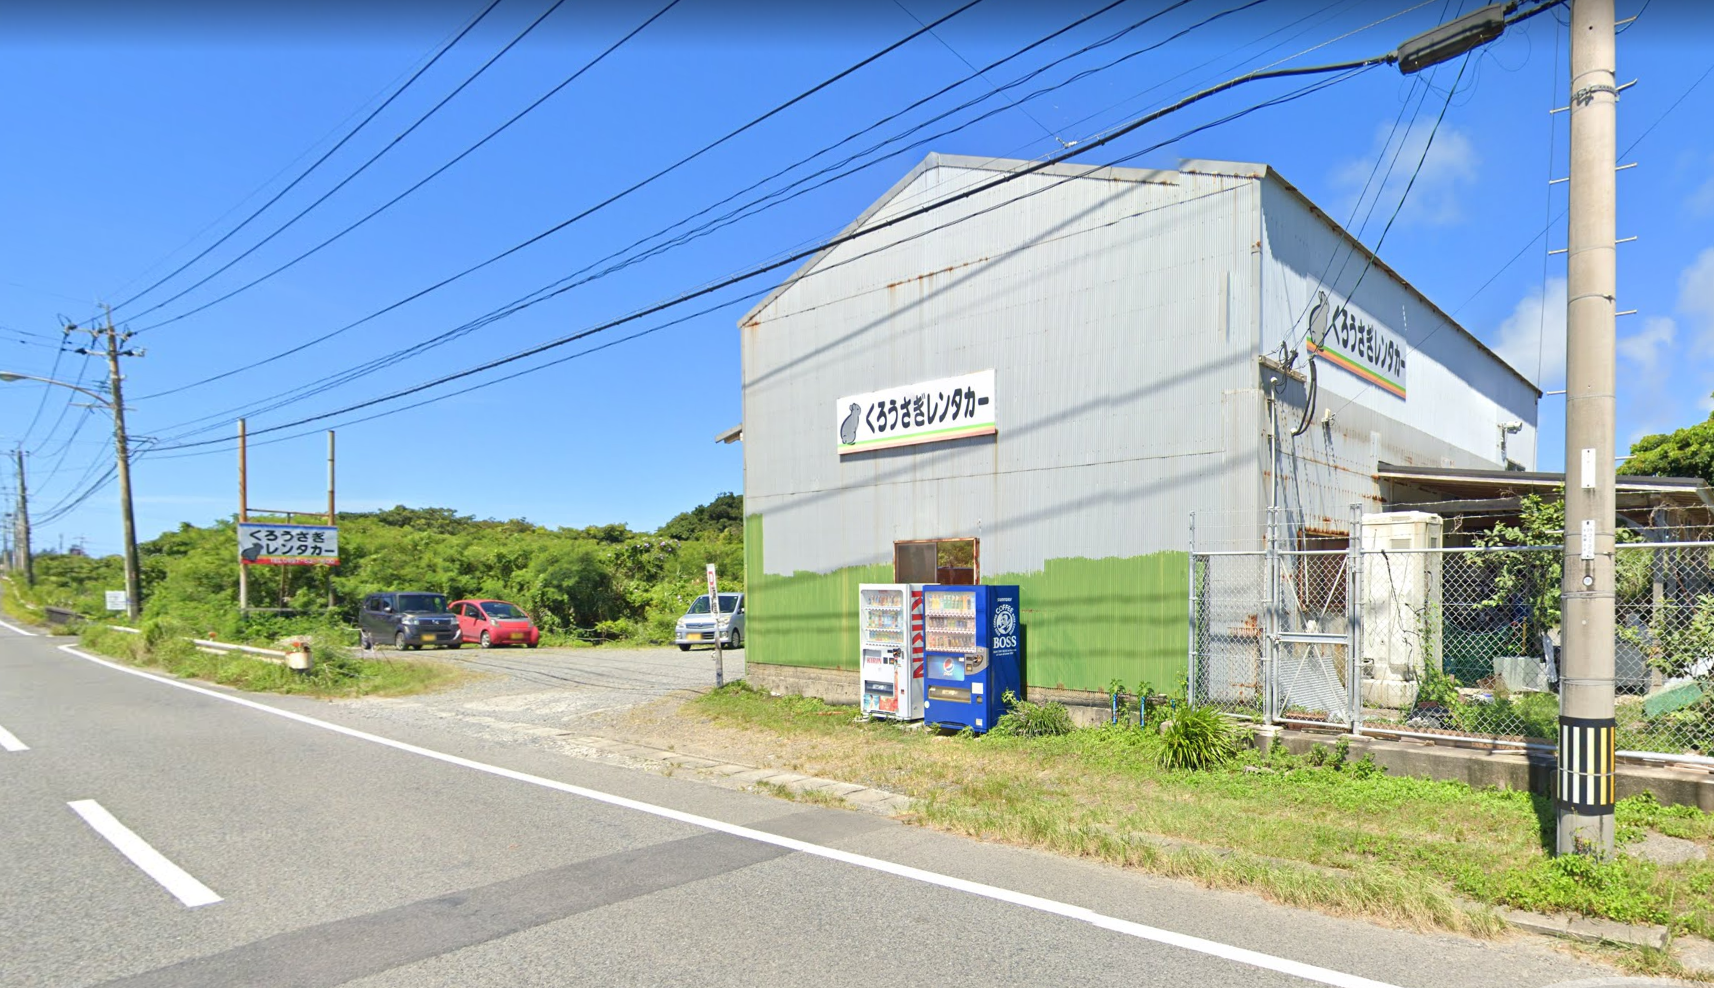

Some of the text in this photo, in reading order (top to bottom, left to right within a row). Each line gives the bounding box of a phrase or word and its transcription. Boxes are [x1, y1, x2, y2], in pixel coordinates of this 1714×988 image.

[1332, 305, 1405, 377] くろうさぎレンタカー
[865, 385, 989, 434] くろうさぎレンタカー
[249, 530, 325, 543] くろうさぎ
[266, 543, 335, 556] レンタカー
[995, 604, 1014, 614] COFFEE
[993, 636, 1017, 649] BOSS
[866, 656, 882, 664] KIRIN
